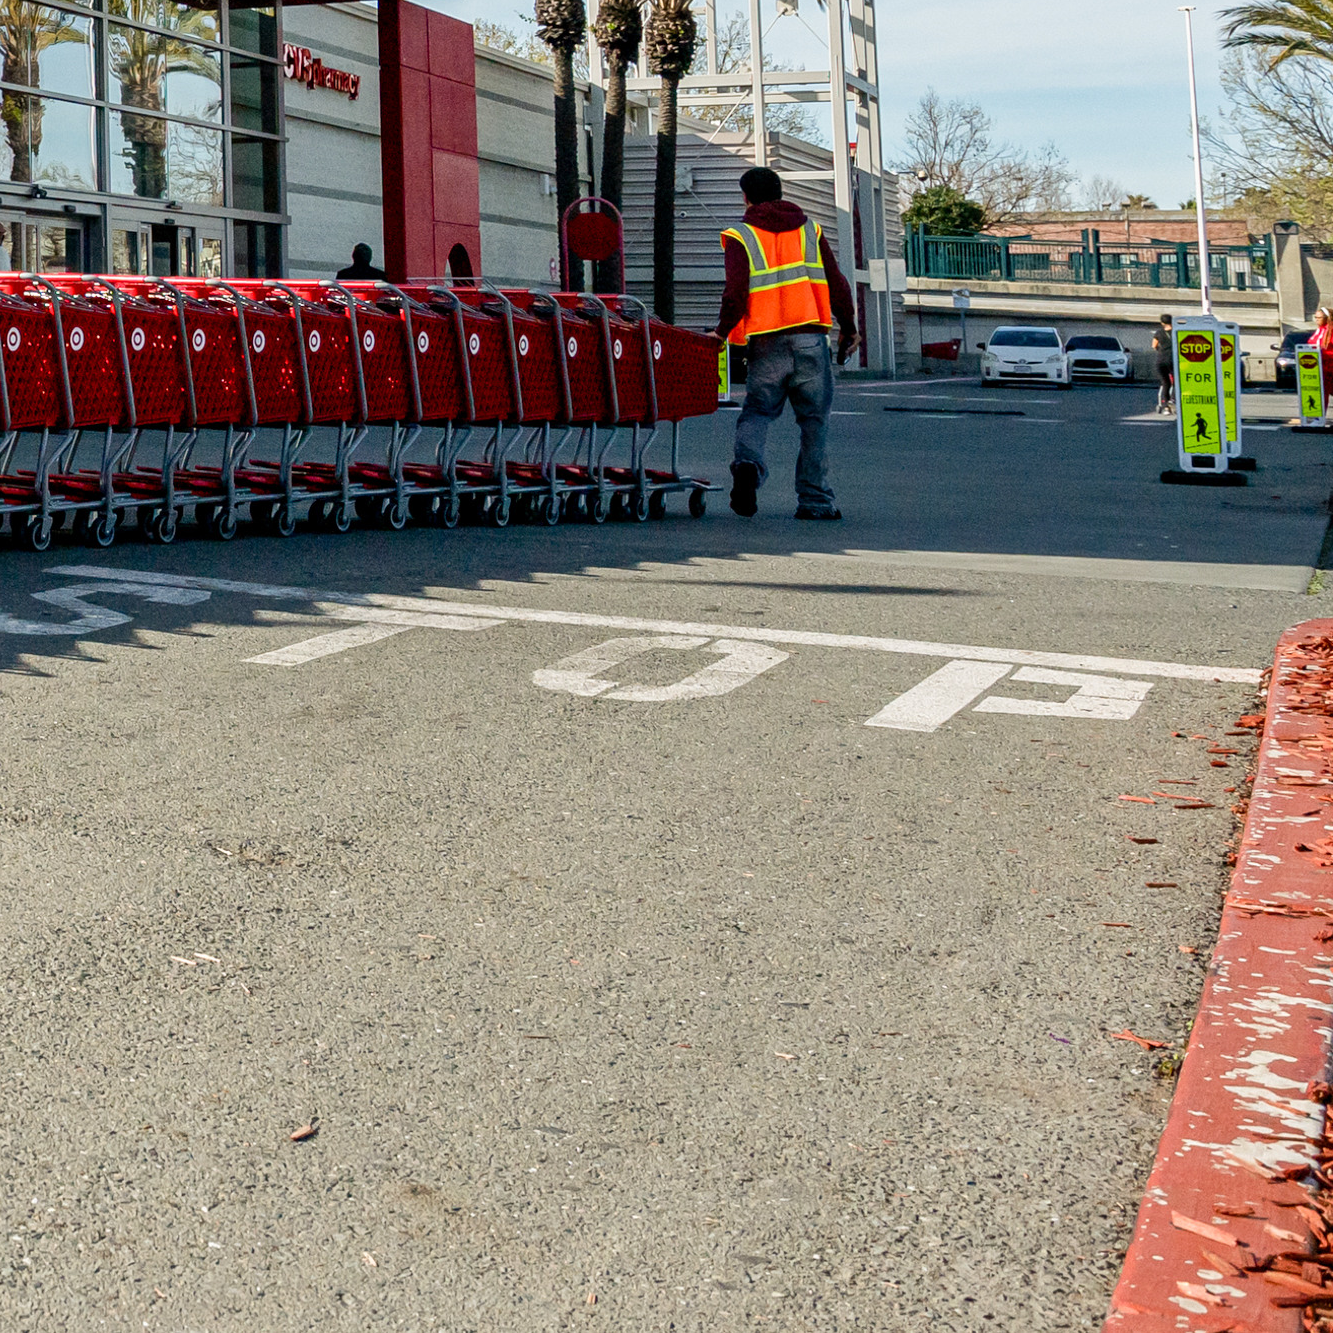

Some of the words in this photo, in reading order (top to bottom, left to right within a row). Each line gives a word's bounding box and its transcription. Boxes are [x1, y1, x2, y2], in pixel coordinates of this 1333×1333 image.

[307, 58, 361, 100] pharmacy
[1180, 343, 1211, 354] STOP
[1186, 373, 1212, 383] FOR
